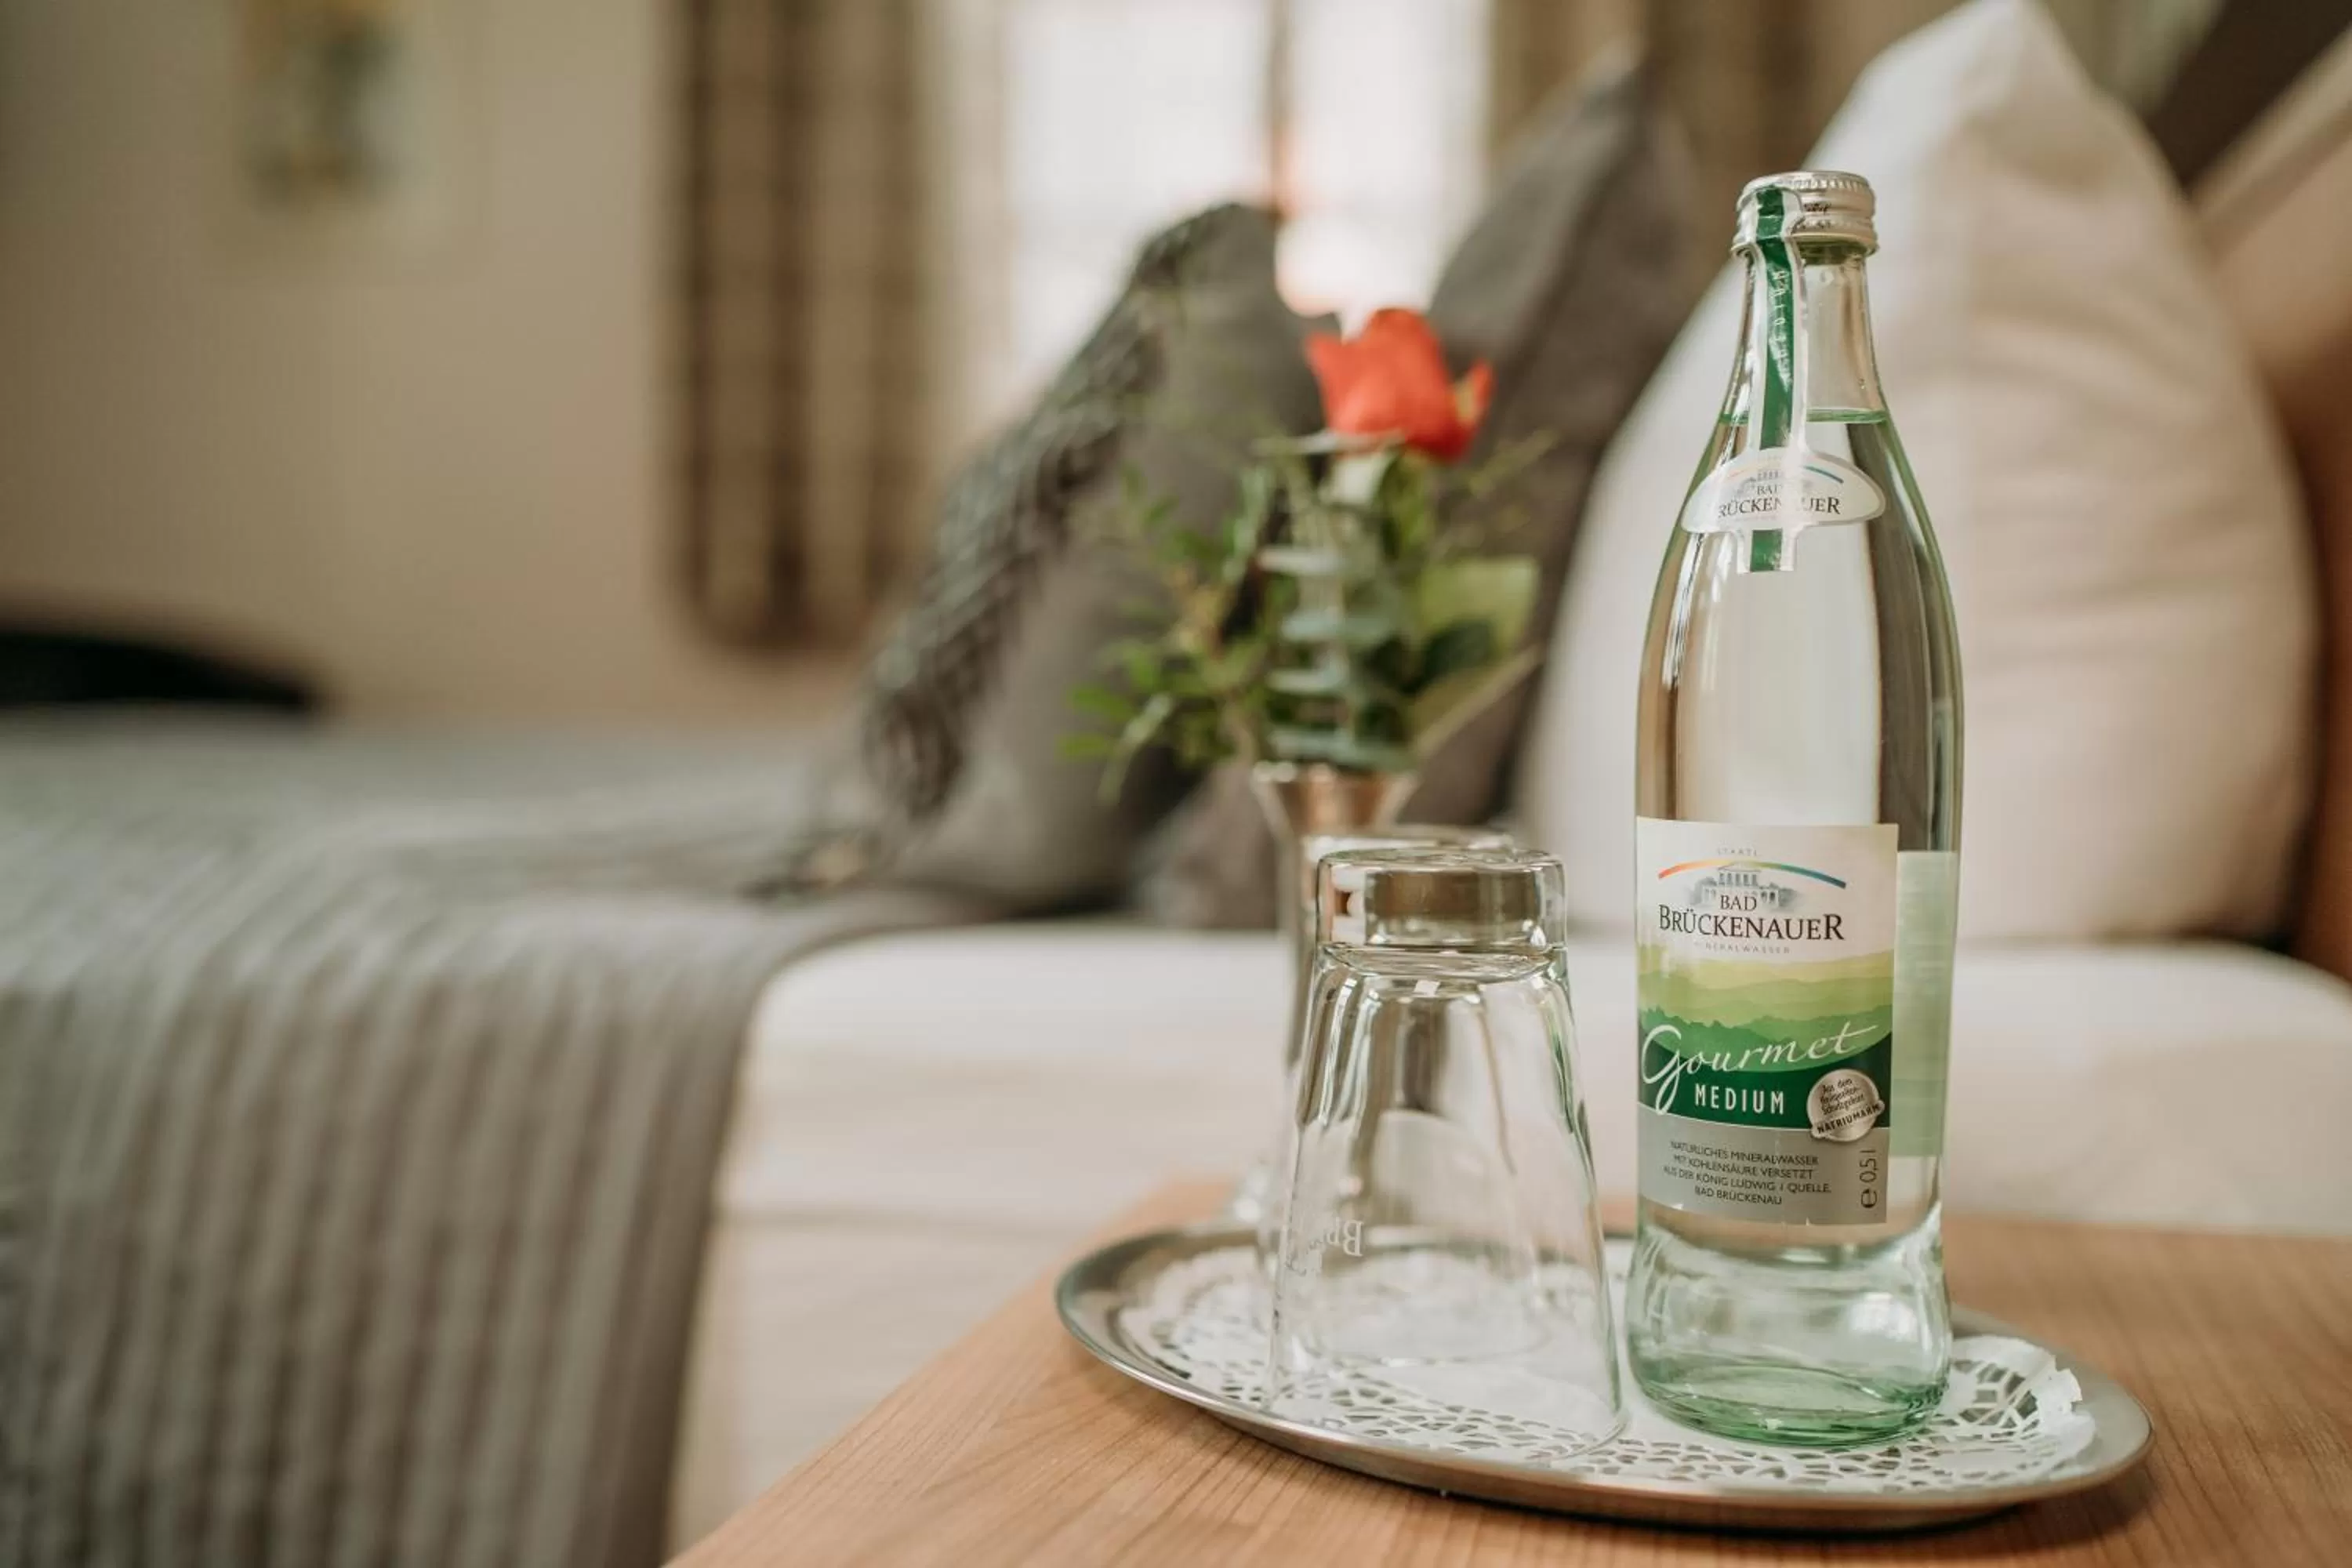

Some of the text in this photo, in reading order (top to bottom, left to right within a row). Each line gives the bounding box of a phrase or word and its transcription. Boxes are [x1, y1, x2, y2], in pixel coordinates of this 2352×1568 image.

[1717, 492, 1842, 519] RÜCKENUER
[1720, 895, 1757, 911] BAD
[1658, 904, 1844, 940] BRÜCKENAUER
[1641, 1021, 1879, 1115] Gourmet
[1694, 1083, 1784, 1115] MEDIUM
[1817, 1103, 1879, 1134] NATRIUMARM
[1730, 1151, 1819, 1166] MINERALWASSER
[1759, 1167, 1813, 1180] VERSETZT
[1694, 1185, 1715, 1197] BAD
[1730, 1178, 1776, 1191] LUDWIG
